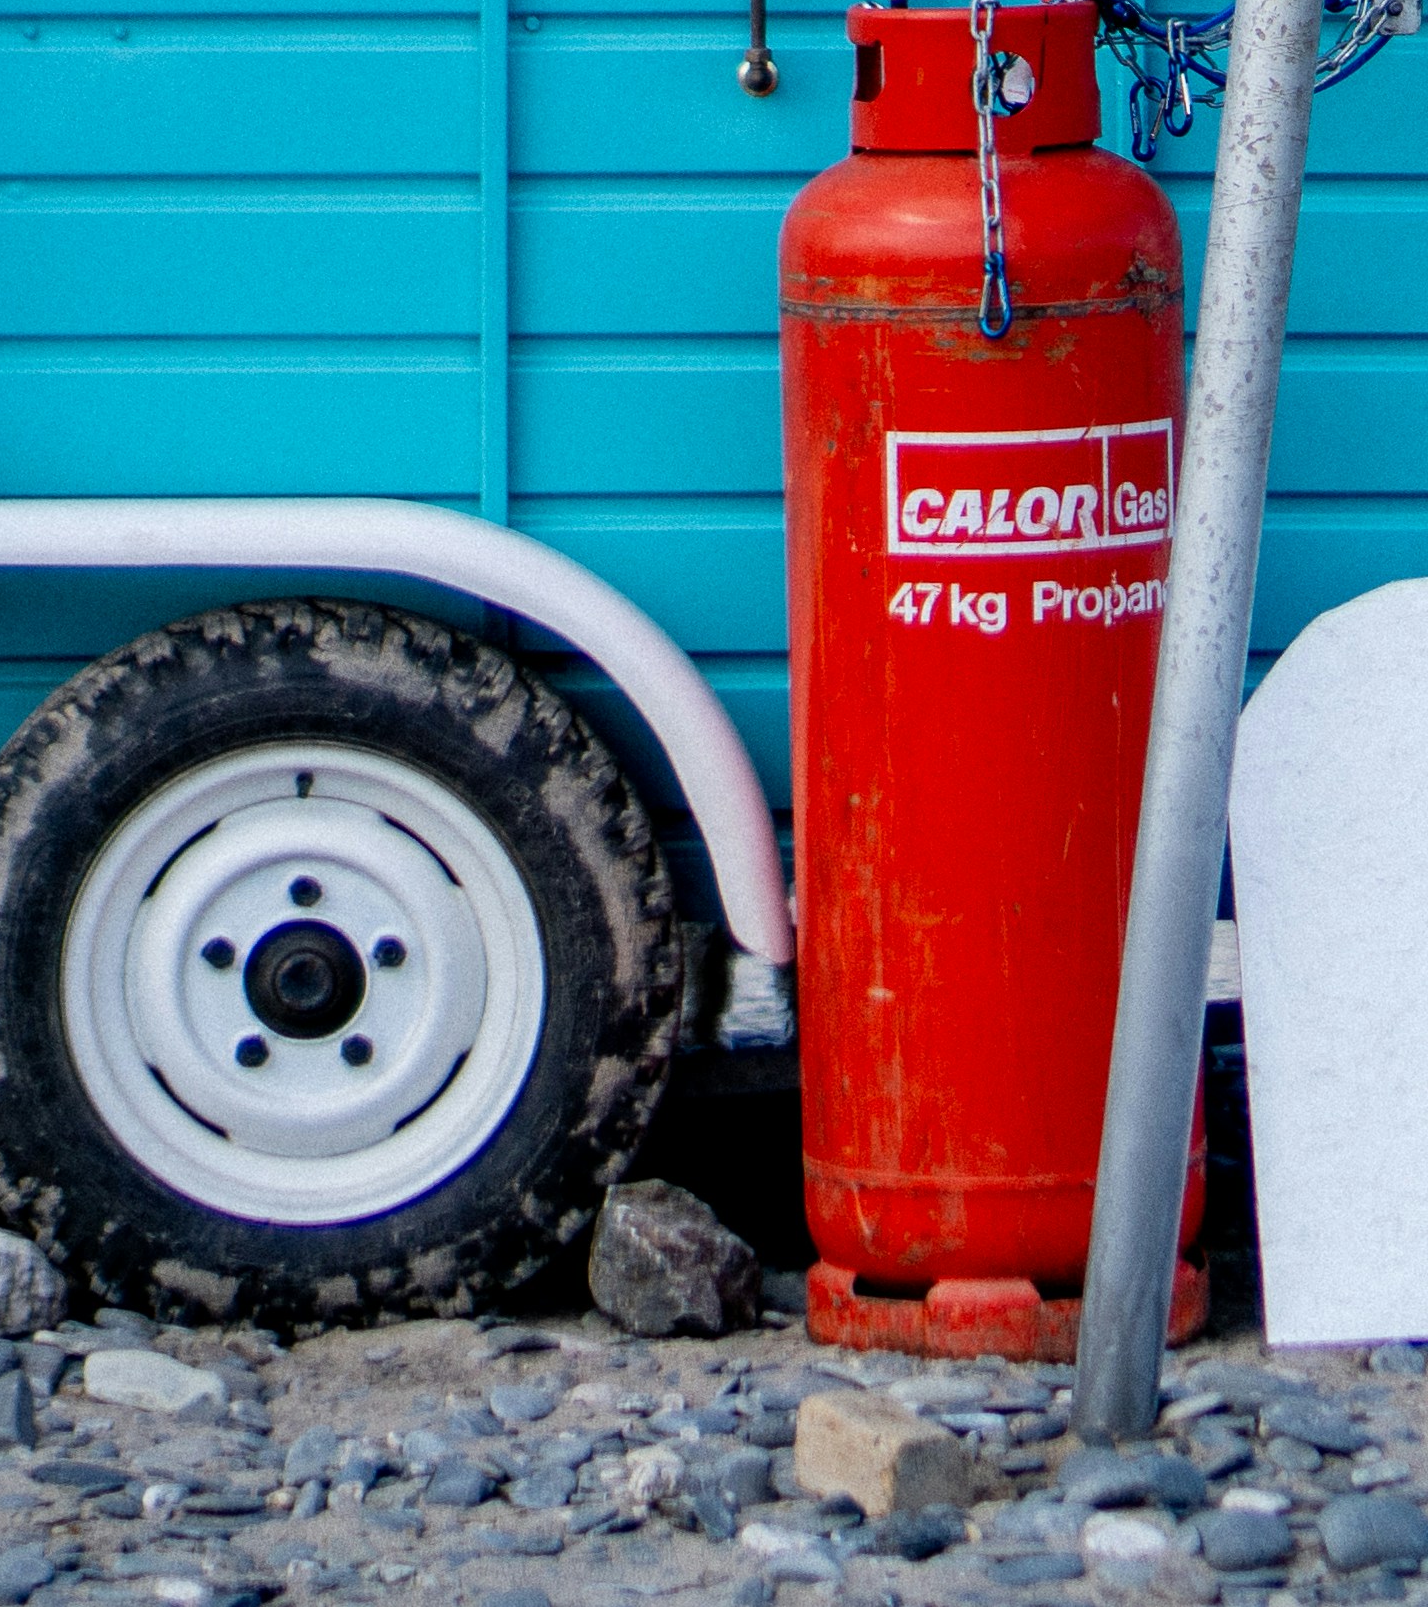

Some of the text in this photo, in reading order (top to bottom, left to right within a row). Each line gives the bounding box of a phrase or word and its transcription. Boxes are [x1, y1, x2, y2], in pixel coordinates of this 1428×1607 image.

[902, 481, 1168, 543] CALOR Gas
[1032, 578, 1170, 627] Propan
